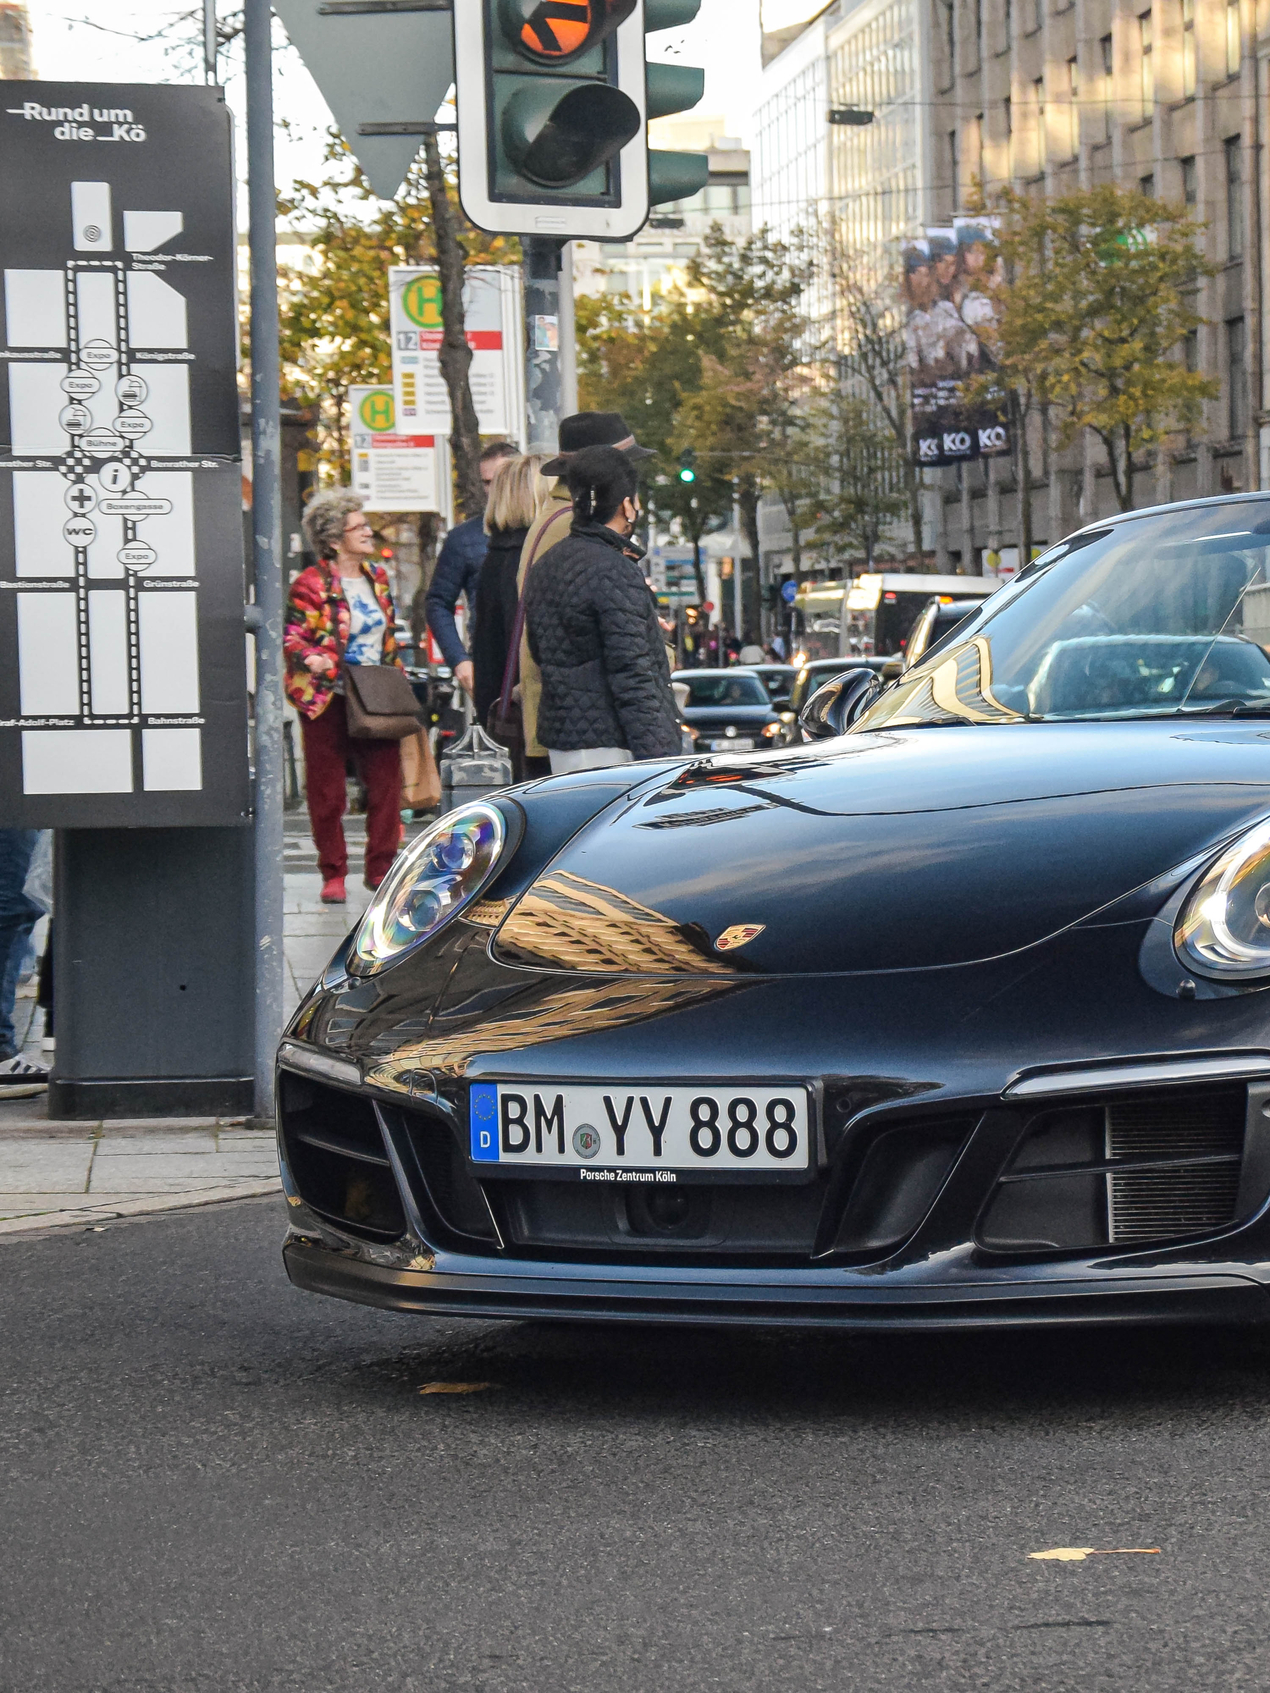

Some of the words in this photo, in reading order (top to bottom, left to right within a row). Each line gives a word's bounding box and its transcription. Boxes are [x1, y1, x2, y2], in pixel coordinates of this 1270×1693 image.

[23, 102, 90, 122] Rund
[93, 108, 134, 122] um
[54, 123, 95, 141] die
[131, 262, 166, 270] Straße
[397, 332, 417, 349] 12
[87, 351, 112, 360] Expo
[69, 381, 94, 390] Expo
[370, 400, 391, 424] H
[120, 420, 145, 429] Expo
[86, 438, 118, 447] Bühne
[150, 460, 199, 468] Benrather
[125, 552, 150, 561] Expo
[143, 580, 200, 588] Grünstraße
[0, 718, 75, 727] raf-Adolf-Platz
[148, 717, 205, 725] Bahnstraße
[500, 1093, 566, 1154] BM
[603, 1095, 673, 1157] YY
[689, 1096, 798, 1158] 888
[480, 1131, 491, 1148] D
[580, 1168, 615, 1181] Porsche
[616, 1169, 654, 1181] Zentrum
[655, 1170, 677, 1182] Köln
